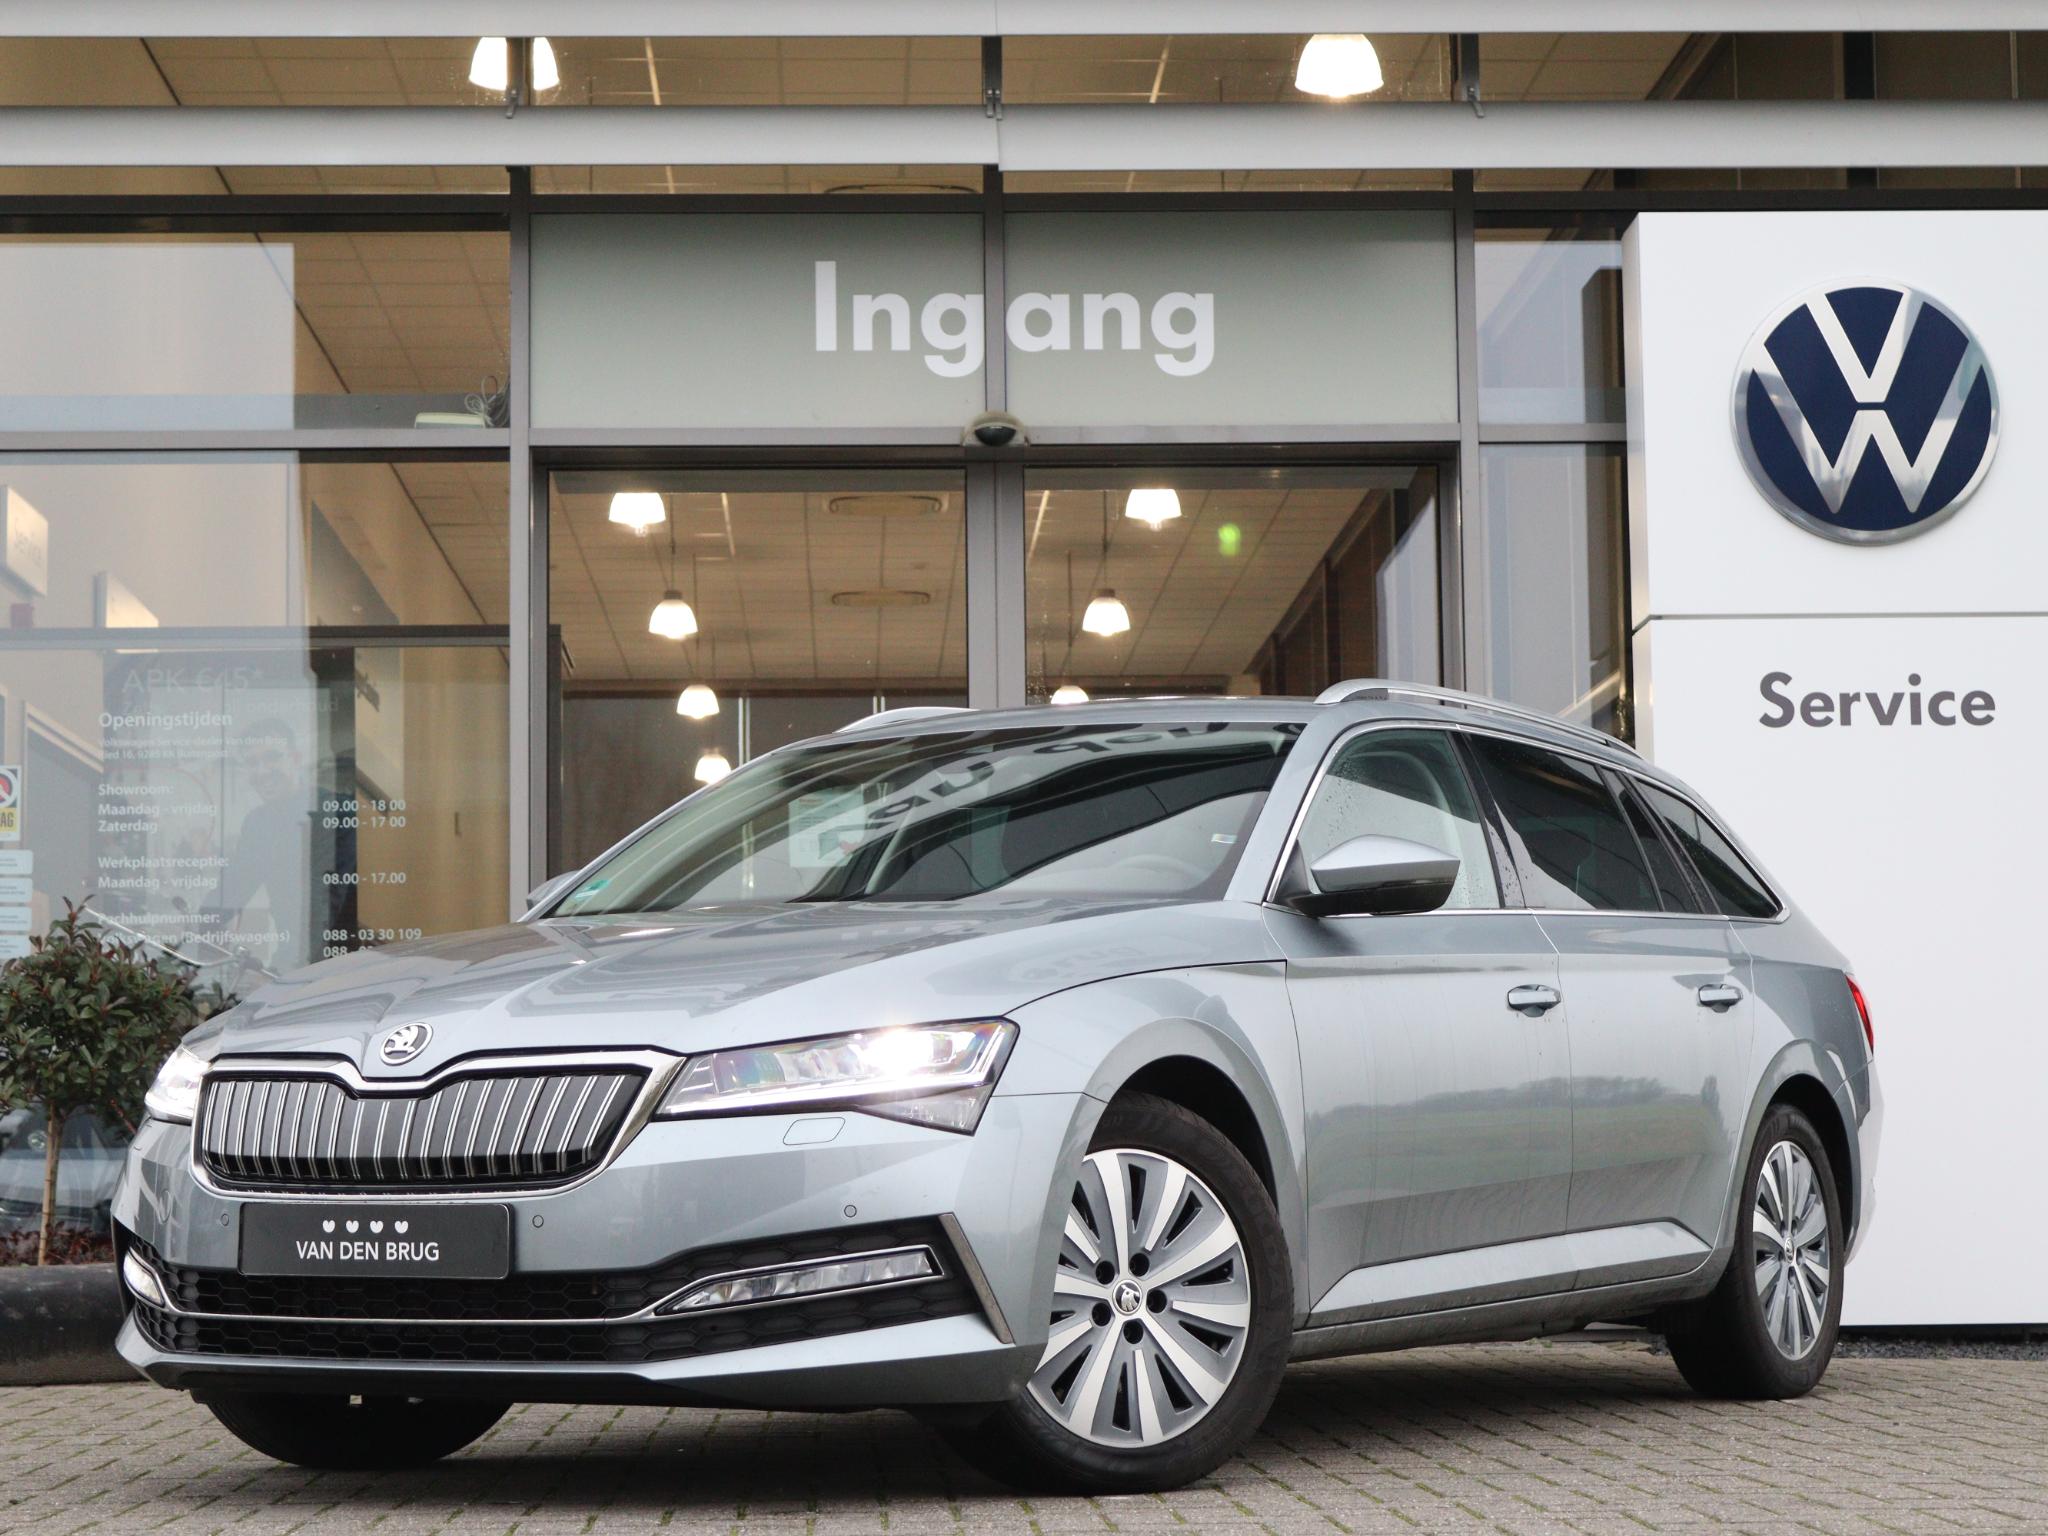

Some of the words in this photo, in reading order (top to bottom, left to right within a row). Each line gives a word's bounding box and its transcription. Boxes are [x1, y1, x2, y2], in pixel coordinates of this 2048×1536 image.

[815, 260, 1215, 378] Ingang
[122, 668, 185, 693] APK
[1758, 671, 1996, 729] Service
[98, 712, 233, 731] Openingstijden
[98, 783, 174, 796] Showroom:
[98, 803, 159, 817] Maandag
[171, 803, 217, 817] vrijdag
[323, 800, 359, 812] 09.00
[98, 820, 158, 834] Zaterdag
[323, 817, 359, 828] 09.00
[98, 856, 229, 870] Werkplaatsreceptie:
[98, 876, 159, 890] Maandag
[171, 876, 218, 890] vrijdag
[323, 873, 359, 885] 08.00
[371, 872, 406, 884] 17.00
[181, 929, 290, 946] (Bedrijfswagens)
[323, 929, 348, 941] 088
[358, 929, 374, 940] 03
[378, 929, 395, 940] 30
[399, 928, 422, 940] 109
[323, 946, 348, 958] 088
[296, 1240, 333, 1260] VAN
[339, 1241, 378, 1260] DEN
[386, 1241, 440, 1262] BRUG
